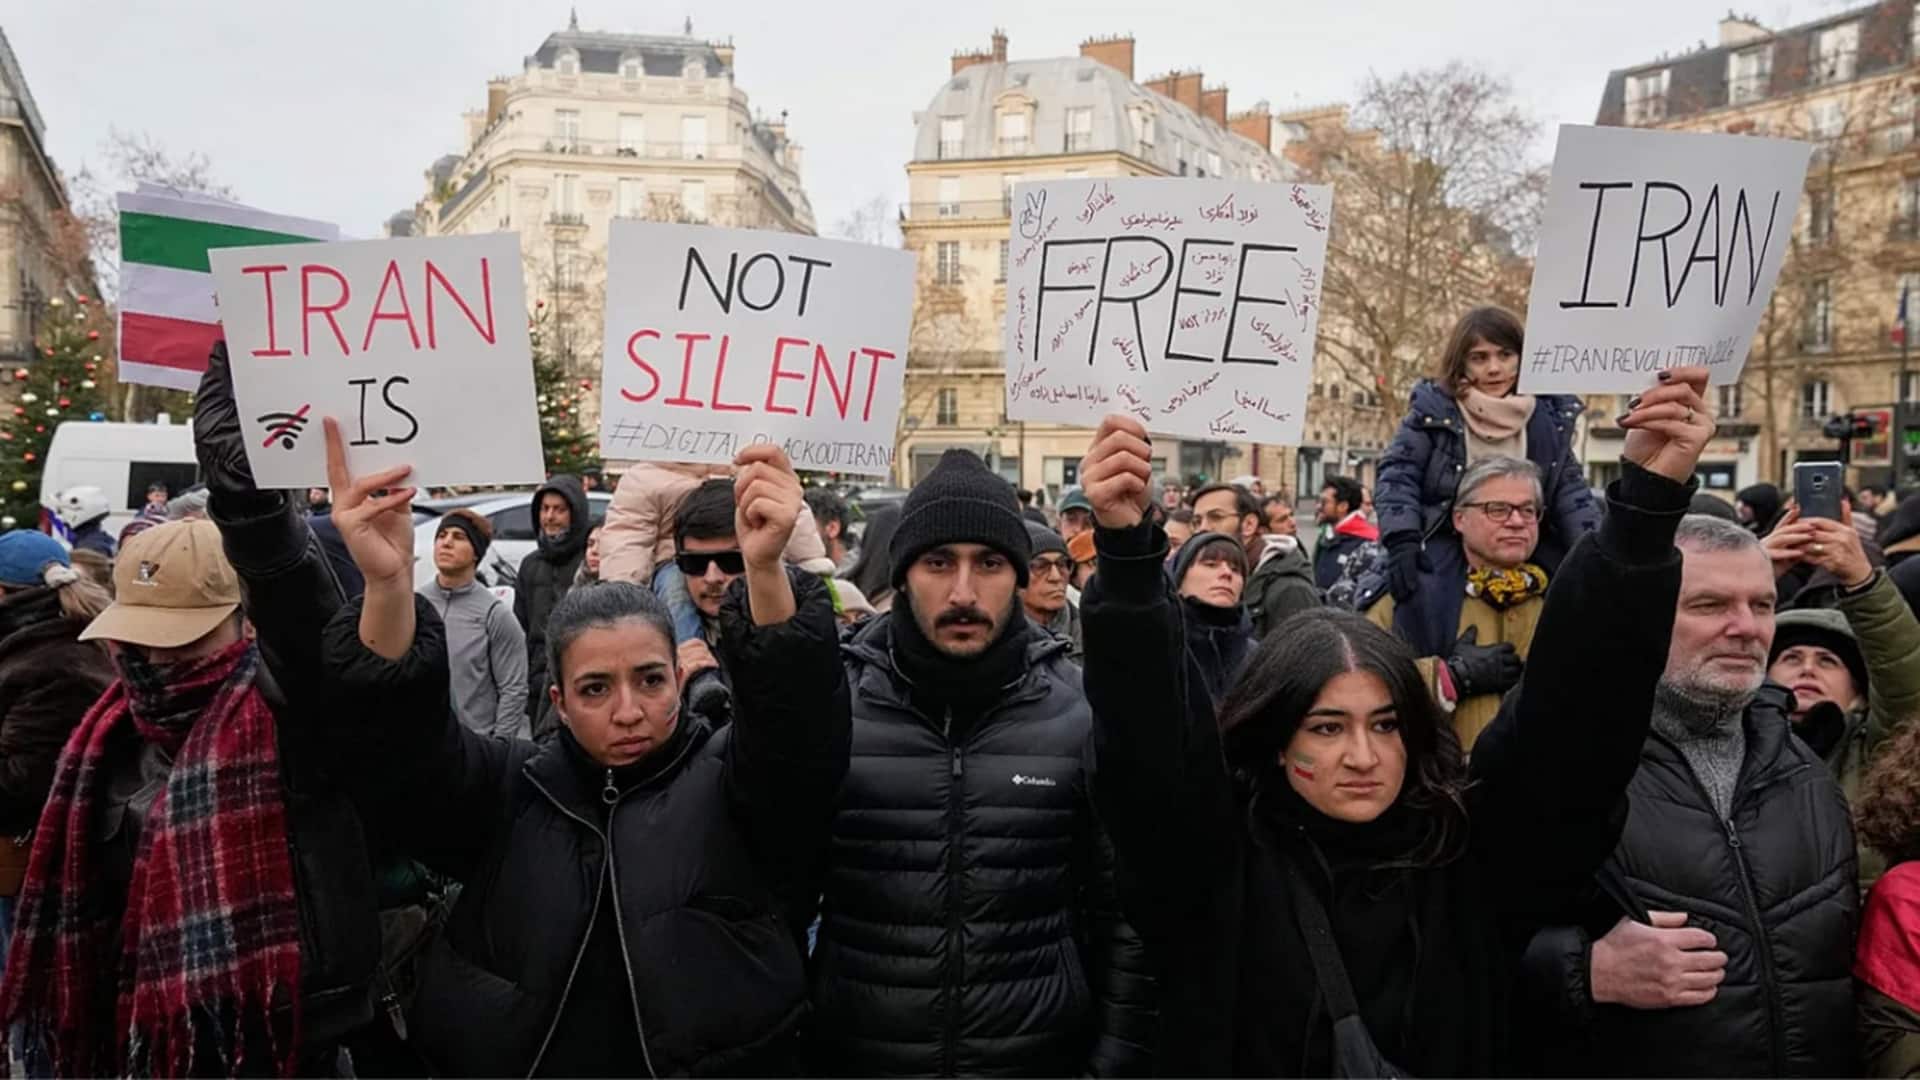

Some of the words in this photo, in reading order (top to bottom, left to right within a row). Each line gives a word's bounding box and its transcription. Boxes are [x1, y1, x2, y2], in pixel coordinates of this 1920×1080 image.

[679, 247, 832, 317] NOT
[1559, 181, 1781, 309] IRAN
[241, 257, 496, 357] IRAN
[1034, 234, 1298, 372] FREE
[348, 376, 418, 446] IS
[620, 329, 896, 422] SILENT
